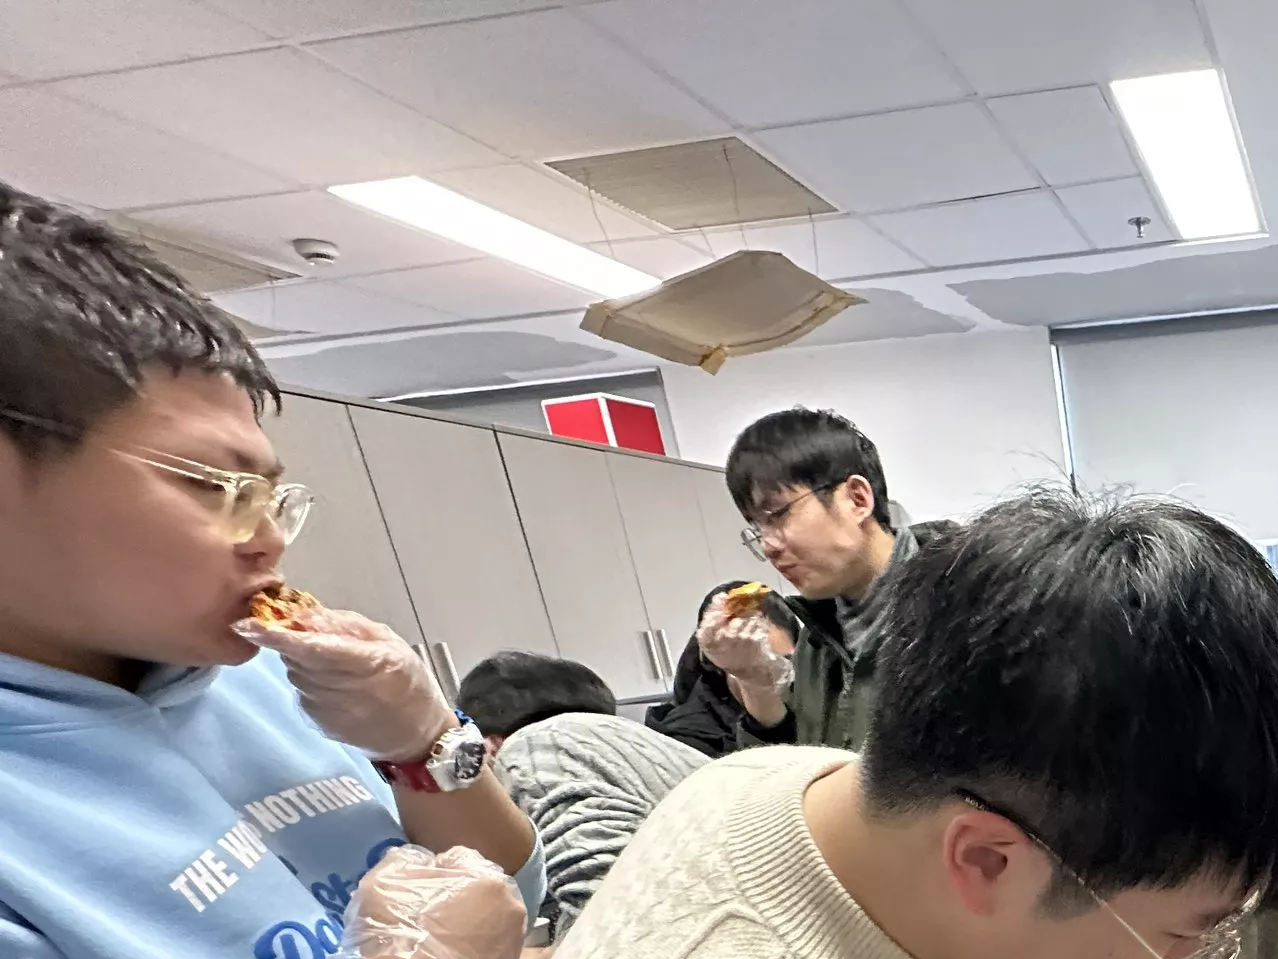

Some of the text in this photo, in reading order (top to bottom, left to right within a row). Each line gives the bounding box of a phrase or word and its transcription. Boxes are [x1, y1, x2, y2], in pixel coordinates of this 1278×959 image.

[169, 775, 376, 913] THE WO NOTHING
